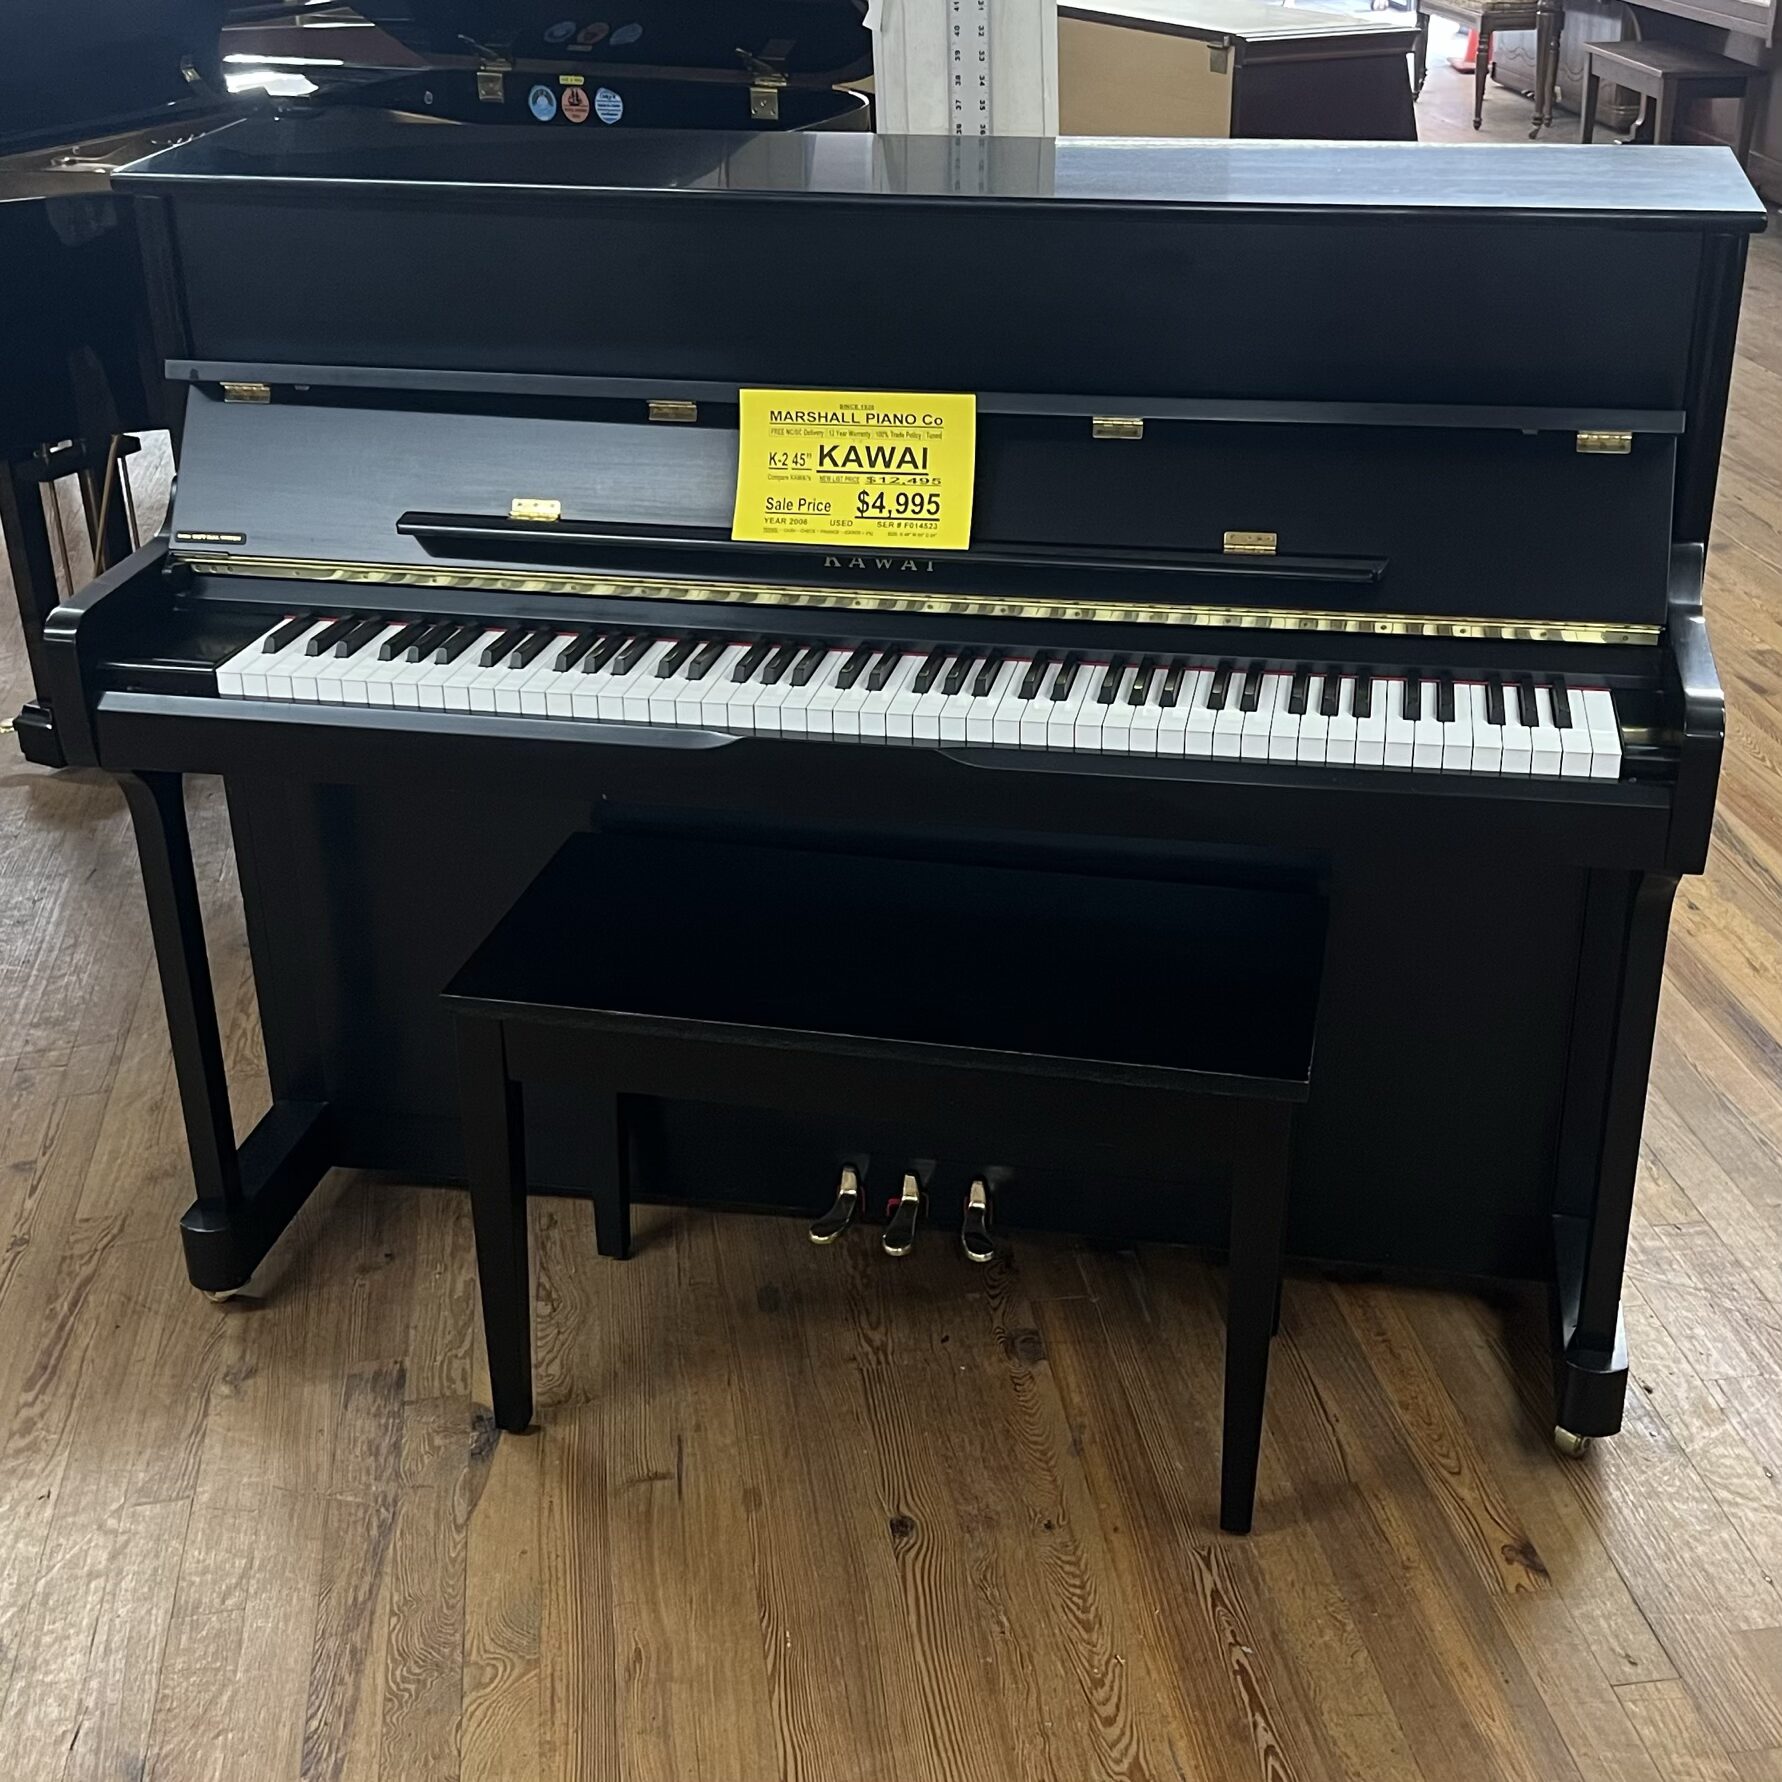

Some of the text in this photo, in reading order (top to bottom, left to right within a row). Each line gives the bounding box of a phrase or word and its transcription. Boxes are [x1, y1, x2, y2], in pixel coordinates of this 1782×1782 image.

[954, 0, 960, 11] 41
[954, 25, 960, 37] 40
[978, 25, 985, 37] 32
[954, 49, 961, 61] 39
[978, 50, 985, 62] 33
[955, 74, 961, 86] 38
[979, 75, 985, 86] 34
[955, 99, 962, 110] 37
[979, 100, 986, 111] 35
[956, 123, 962, 135] 36
[980, 124, 986, 135] 36
[770, 410, 943, 426] MARSHALL PIANO Co
[770, 428, 785, 436] FREE
[803, 428, 824, 438] Delivery
[890, 430, 904, 438] Trade
[905, 431, 921, 440] Policy
[769, 451, 788, 467] K-2
[818, 444, 928, 471] KAWAI
[832, 475, 844, 483] LIST
[765, 497, 831, 513] Sale Price
[856, 489, 940, 517] $4,995
[764, 517, 787, 525] YEAR
[824, 556, 934, 572] KAWAI
